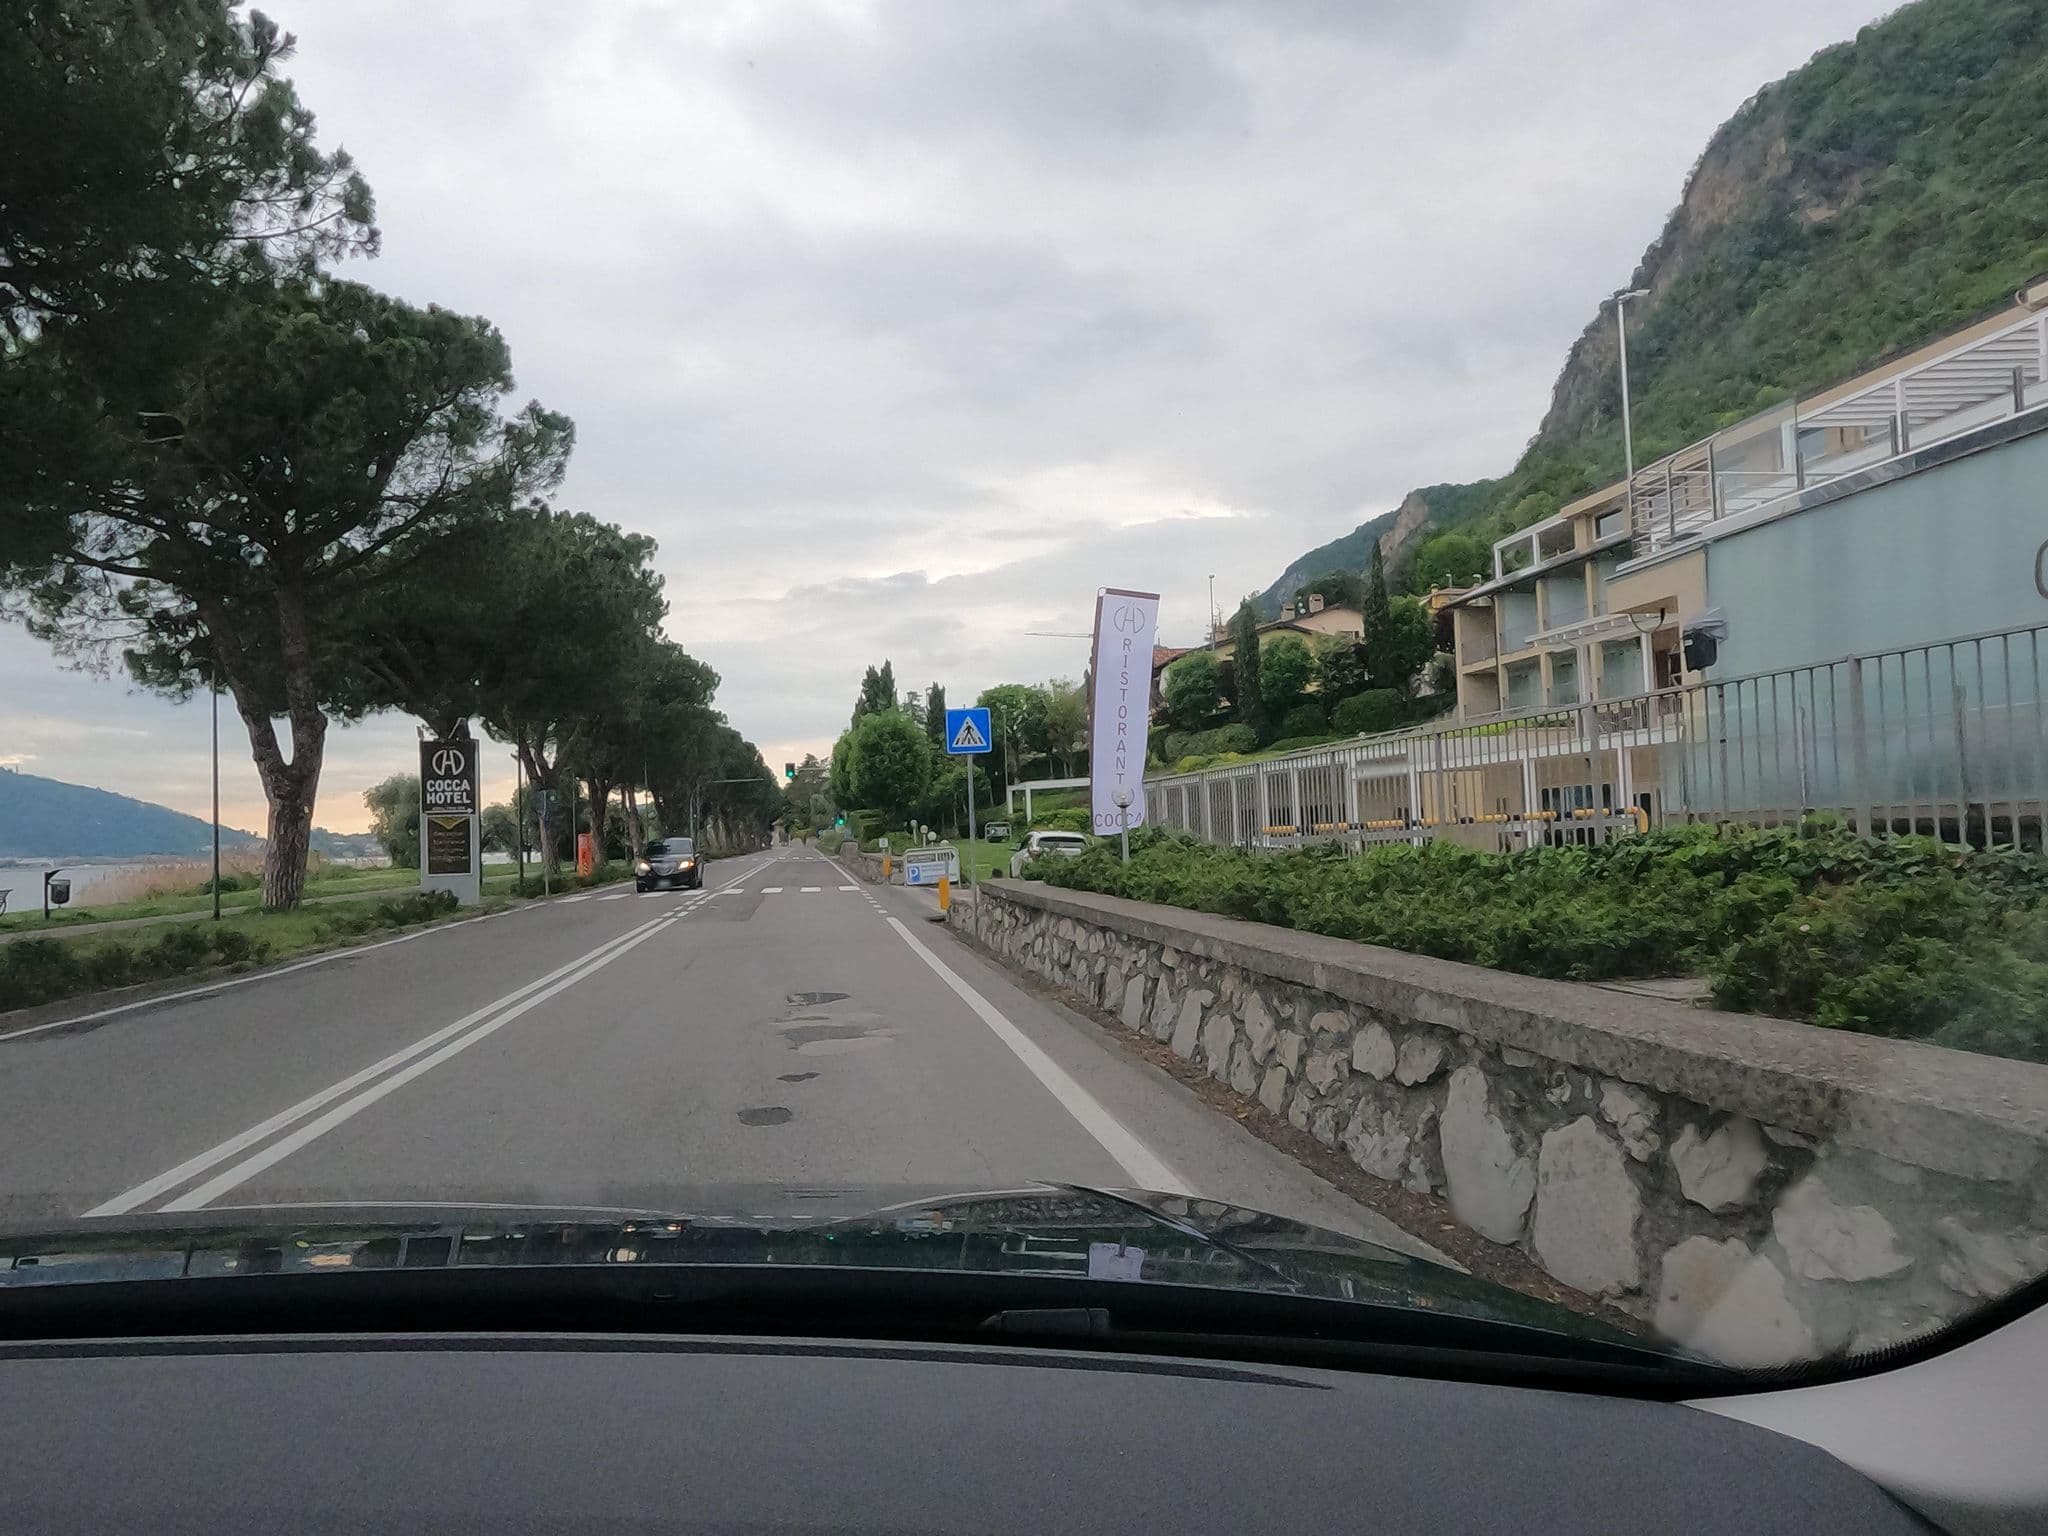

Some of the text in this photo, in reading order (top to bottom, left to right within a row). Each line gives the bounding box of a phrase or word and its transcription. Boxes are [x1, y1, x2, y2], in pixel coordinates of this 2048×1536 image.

[1116, 638, 1132, 785] RISTORANT
[426, 779, 471, 792] COCCA
[426, 791, 472, 804] HOTEL
[909, 867, 919, 881] P
